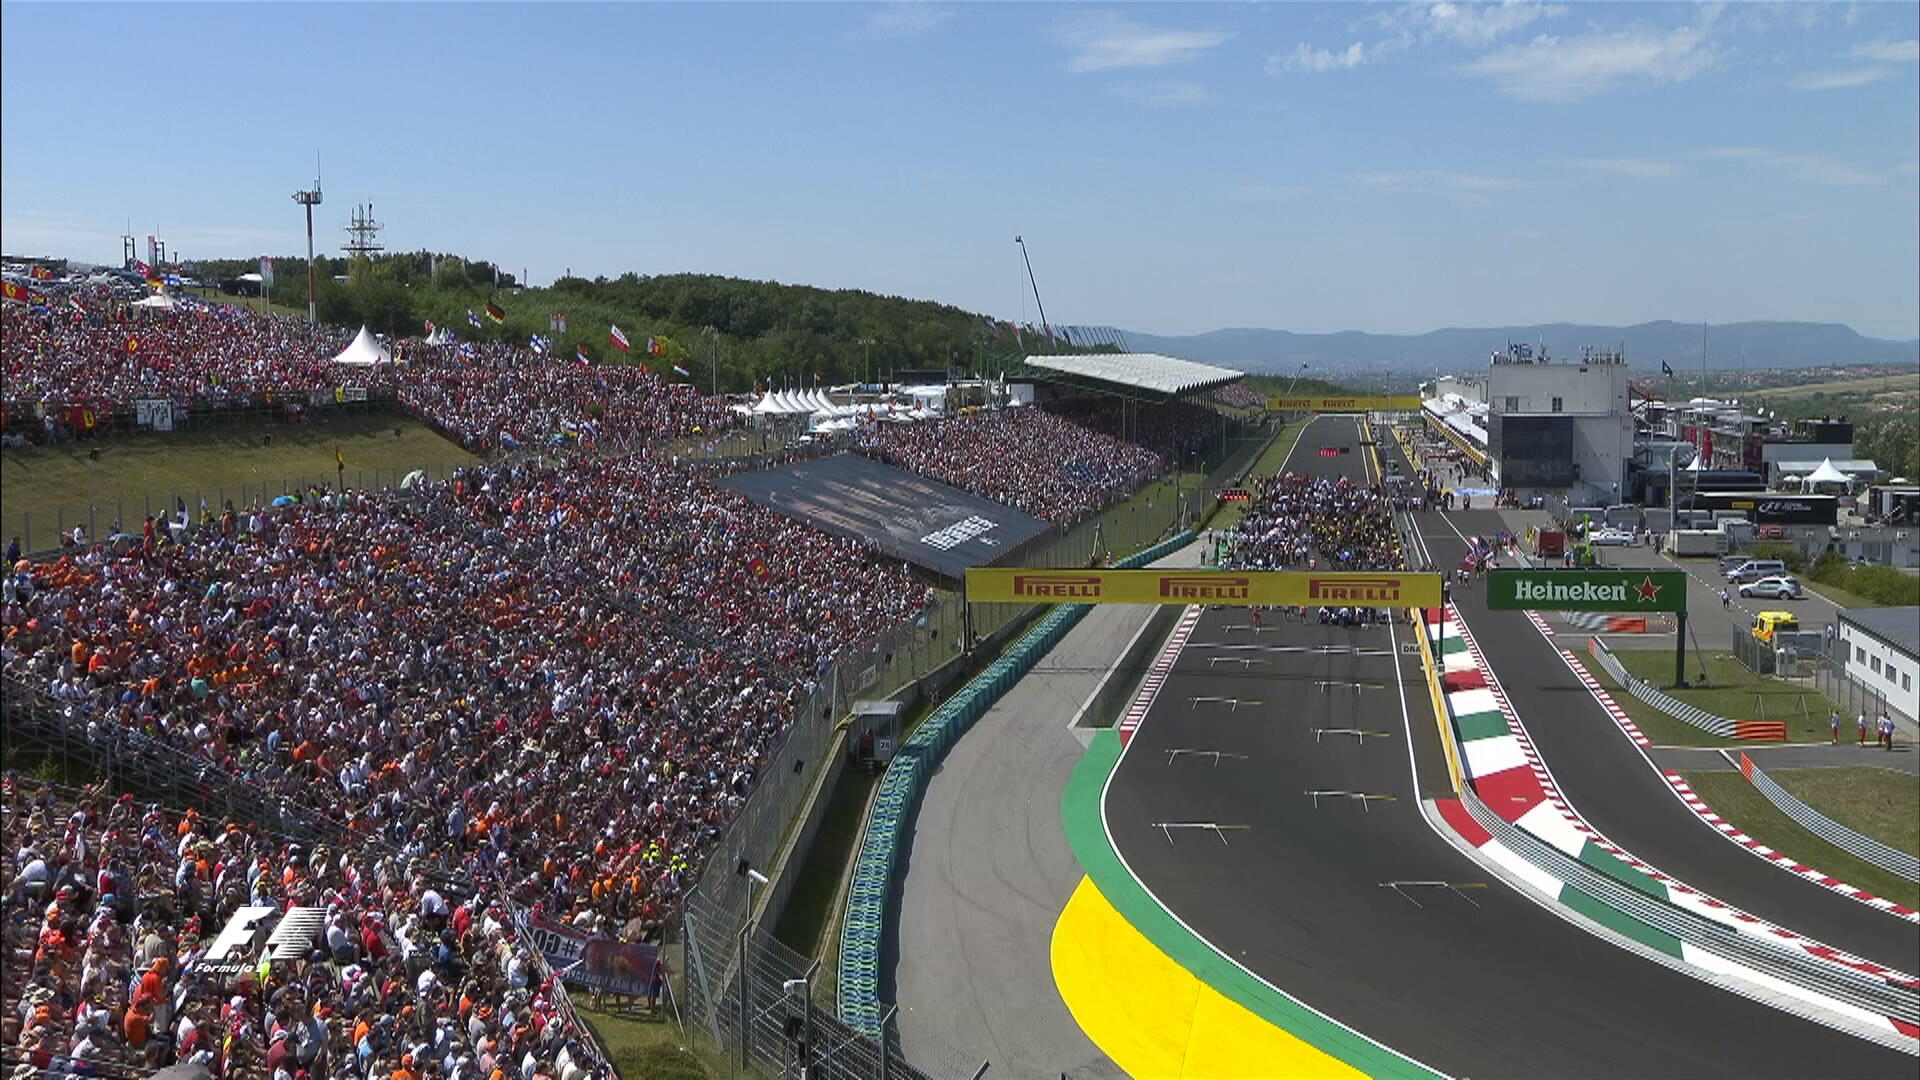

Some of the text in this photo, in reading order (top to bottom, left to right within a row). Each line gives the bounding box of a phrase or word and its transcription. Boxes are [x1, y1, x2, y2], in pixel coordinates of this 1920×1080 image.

[1014, 576, 1103, 597] PIRELLI
[1160, 577, 1249, 599] PIRELLI
[1309, 579, 1401, 600] PIRELLI
[1514, 579, 1627, 601] Heineken
